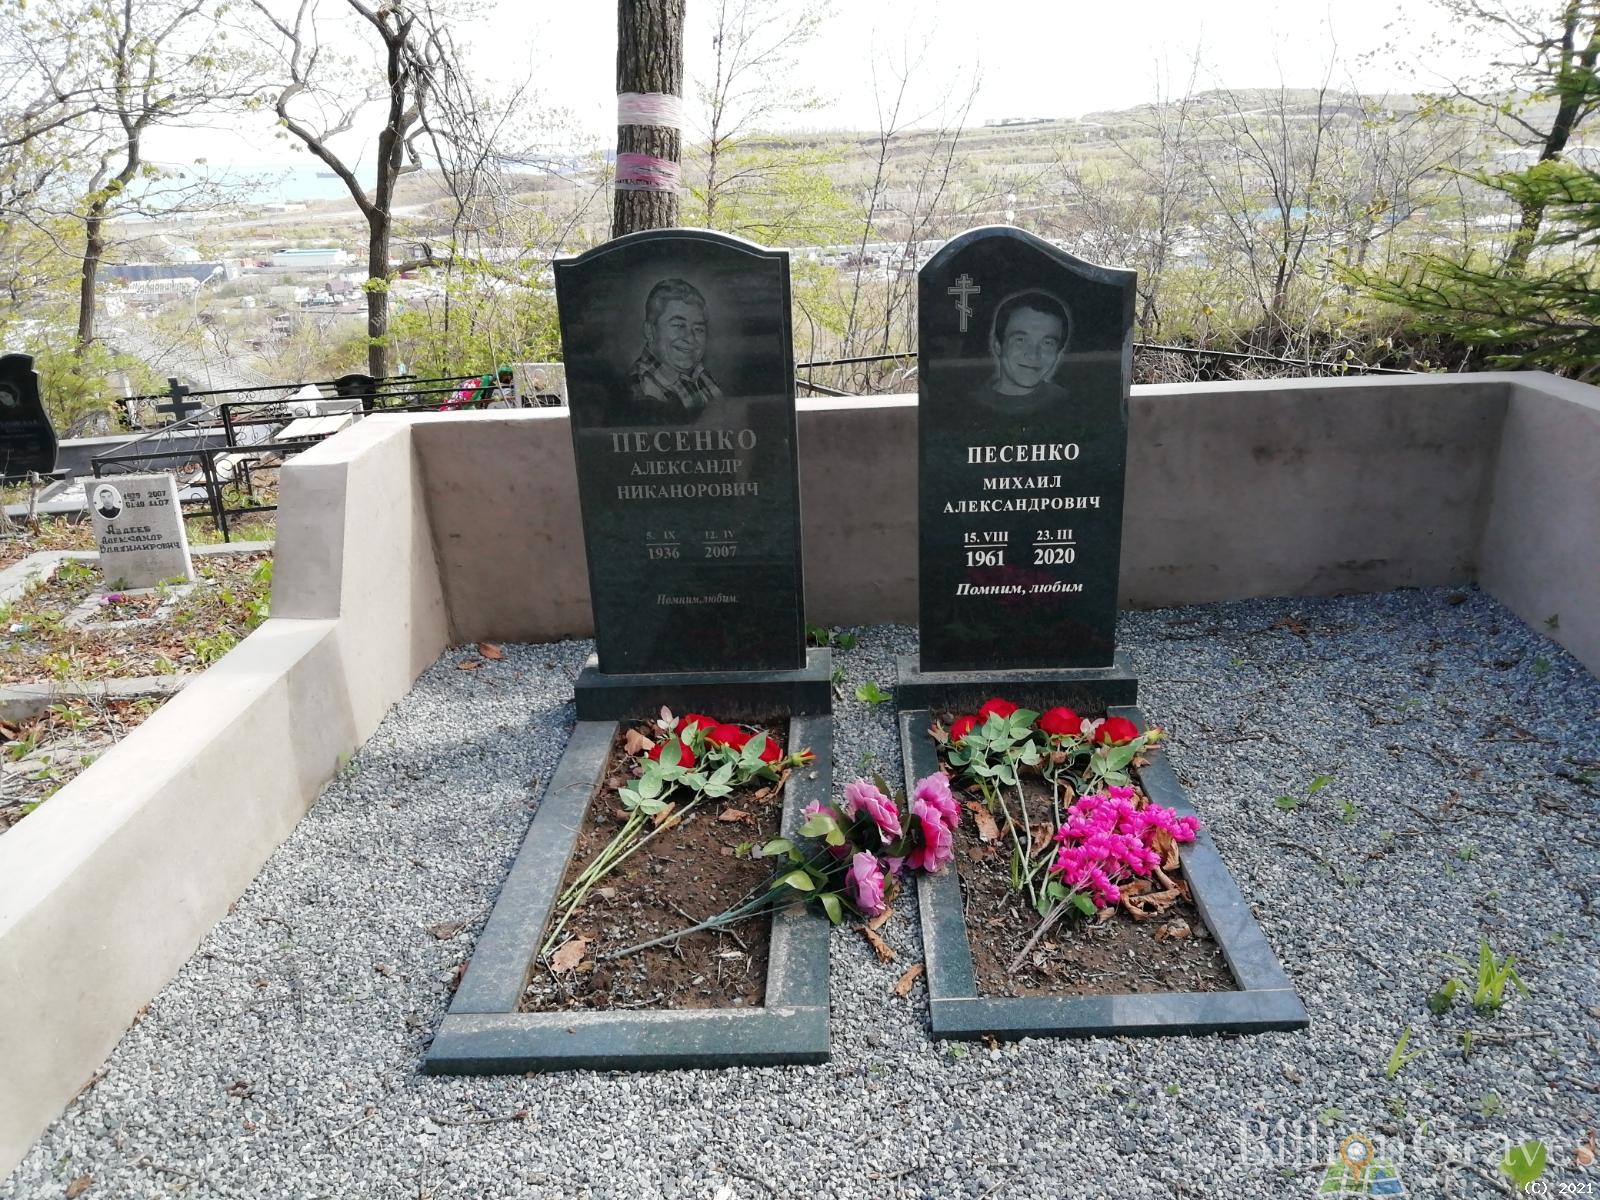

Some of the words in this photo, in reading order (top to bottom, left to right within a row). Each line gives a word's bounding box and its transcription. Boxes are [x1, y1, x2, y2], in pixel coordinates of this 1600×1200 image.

[611, 429, 757, 453] ПЕСЕНКО
[967, 443, 1080, 464] ПЕСЕНКО
[630, 459, 743, 476] АЛЕКСАНДР
[617, 482, 759, 500] НИКАНОРОВИЧ
[982, 475, 1062, 491] МИХАИЛ
[943, 496, 1101, 514] АЛЕКСАНДРОВИЧ
[964, 532, 980, 543] 15.
[983, 531, 1009, 542] VIII
[1036, 530, 1054, 541] 23.
[1056, 529, 1073, 540] III
[648, 547, 681, 560] 1936
[704, 545, 737, 558] 2007
[966, 550, 1005, 567] 1961
[1033, 548, 1075, 565] 2020
[956, 583, 1026, 596] Помним,
[1028, 580, 1084, 594] любим
